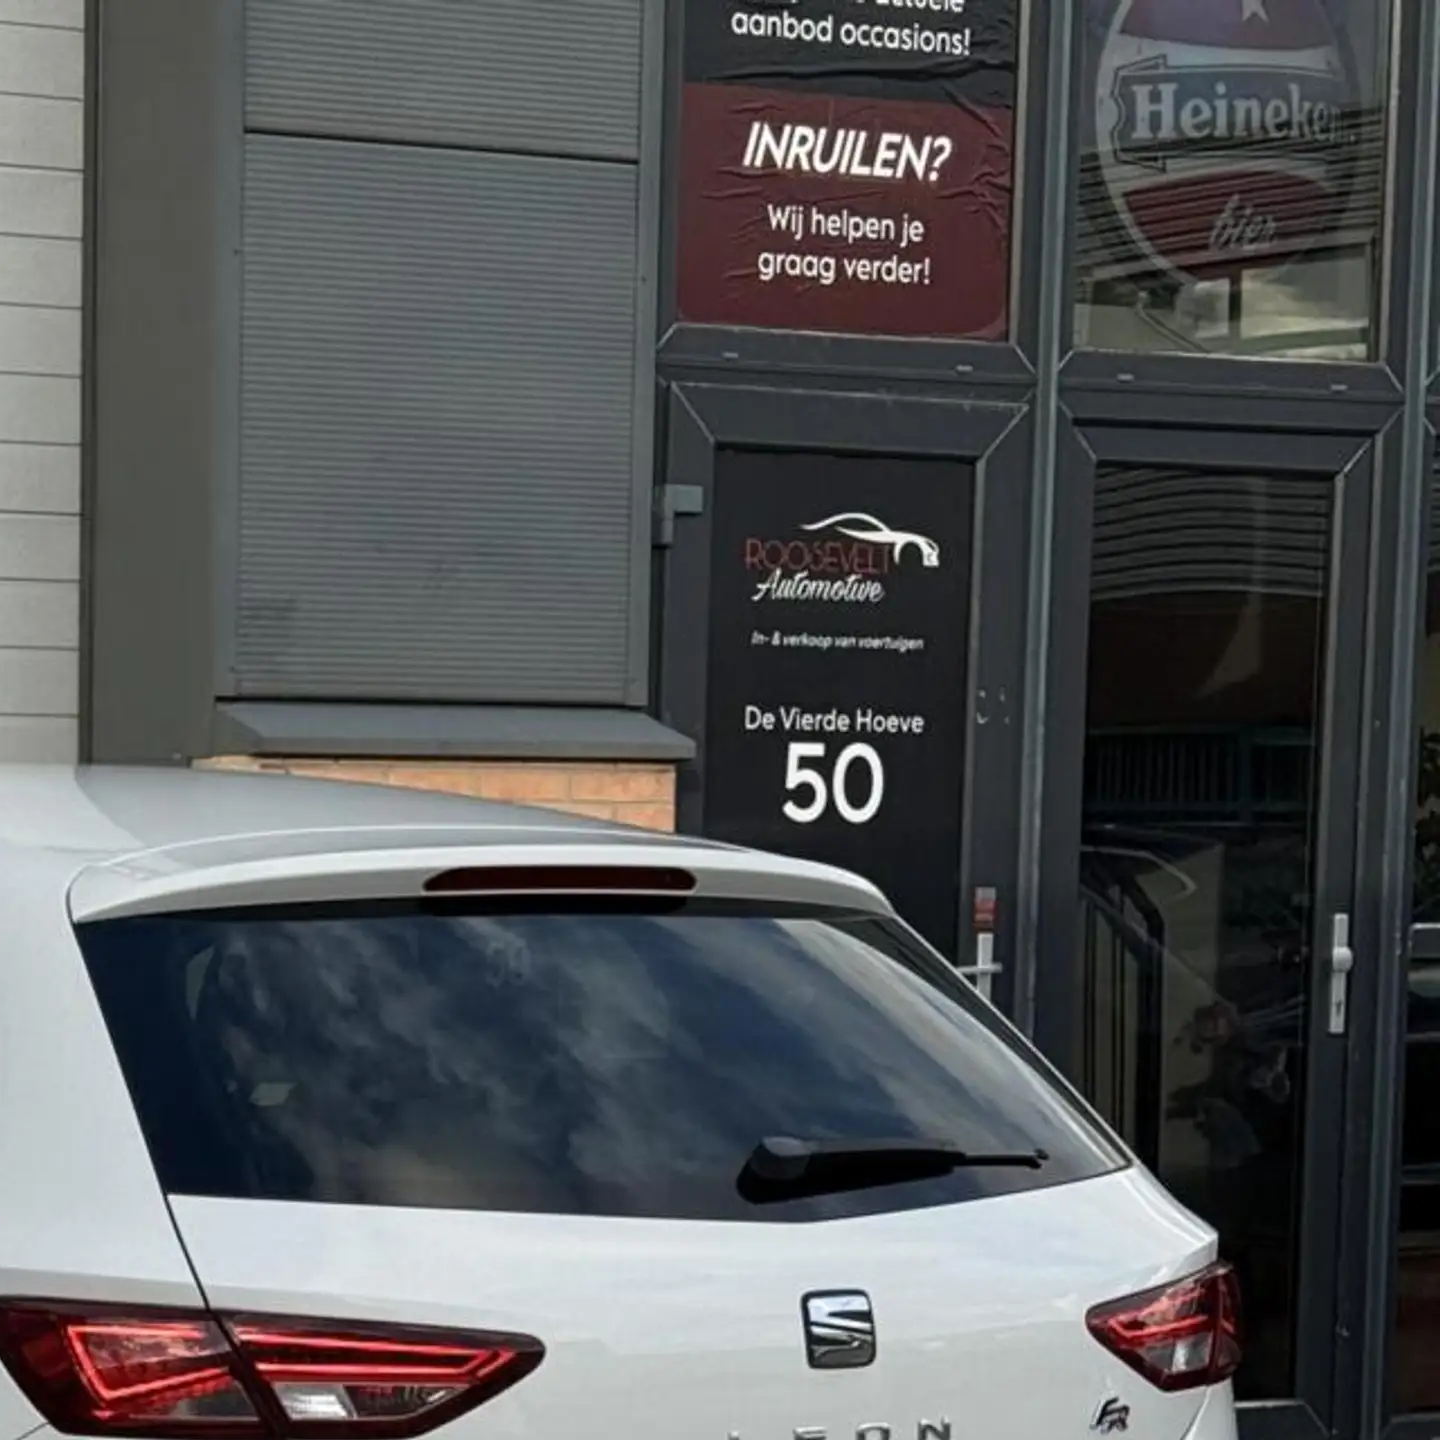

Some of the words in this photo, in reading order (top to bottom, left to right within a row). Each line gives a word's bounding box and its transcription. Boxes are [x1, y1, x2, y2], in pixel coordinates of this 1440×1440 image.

[731, 11, 833, 43] aanbod
[840, 22, 971, 56] occasions!
[742, 121, 953, 182] INRUILEN?
[767, 203, 804, 241] Wij
[811, 207, 895, 244] helpen
[899, 213, 925, 248] je
[758, 252, 836, 285] graag
[844, 254, 932, 285] verder!
[744, 537, 892, 574] ROOSEVELT
[751, 568, 885, 602] Automotive
[783, 633, 833, 650] verkoop
[835, 636, 857, 648] van
[858, 636, 925, 653] voertuigen
[744, 705, 776, 730] De
[779, 706, 851, 732] Vierde
[856, 708, 925, 733] Hoeve
[782, 742, 884, 824] 50
